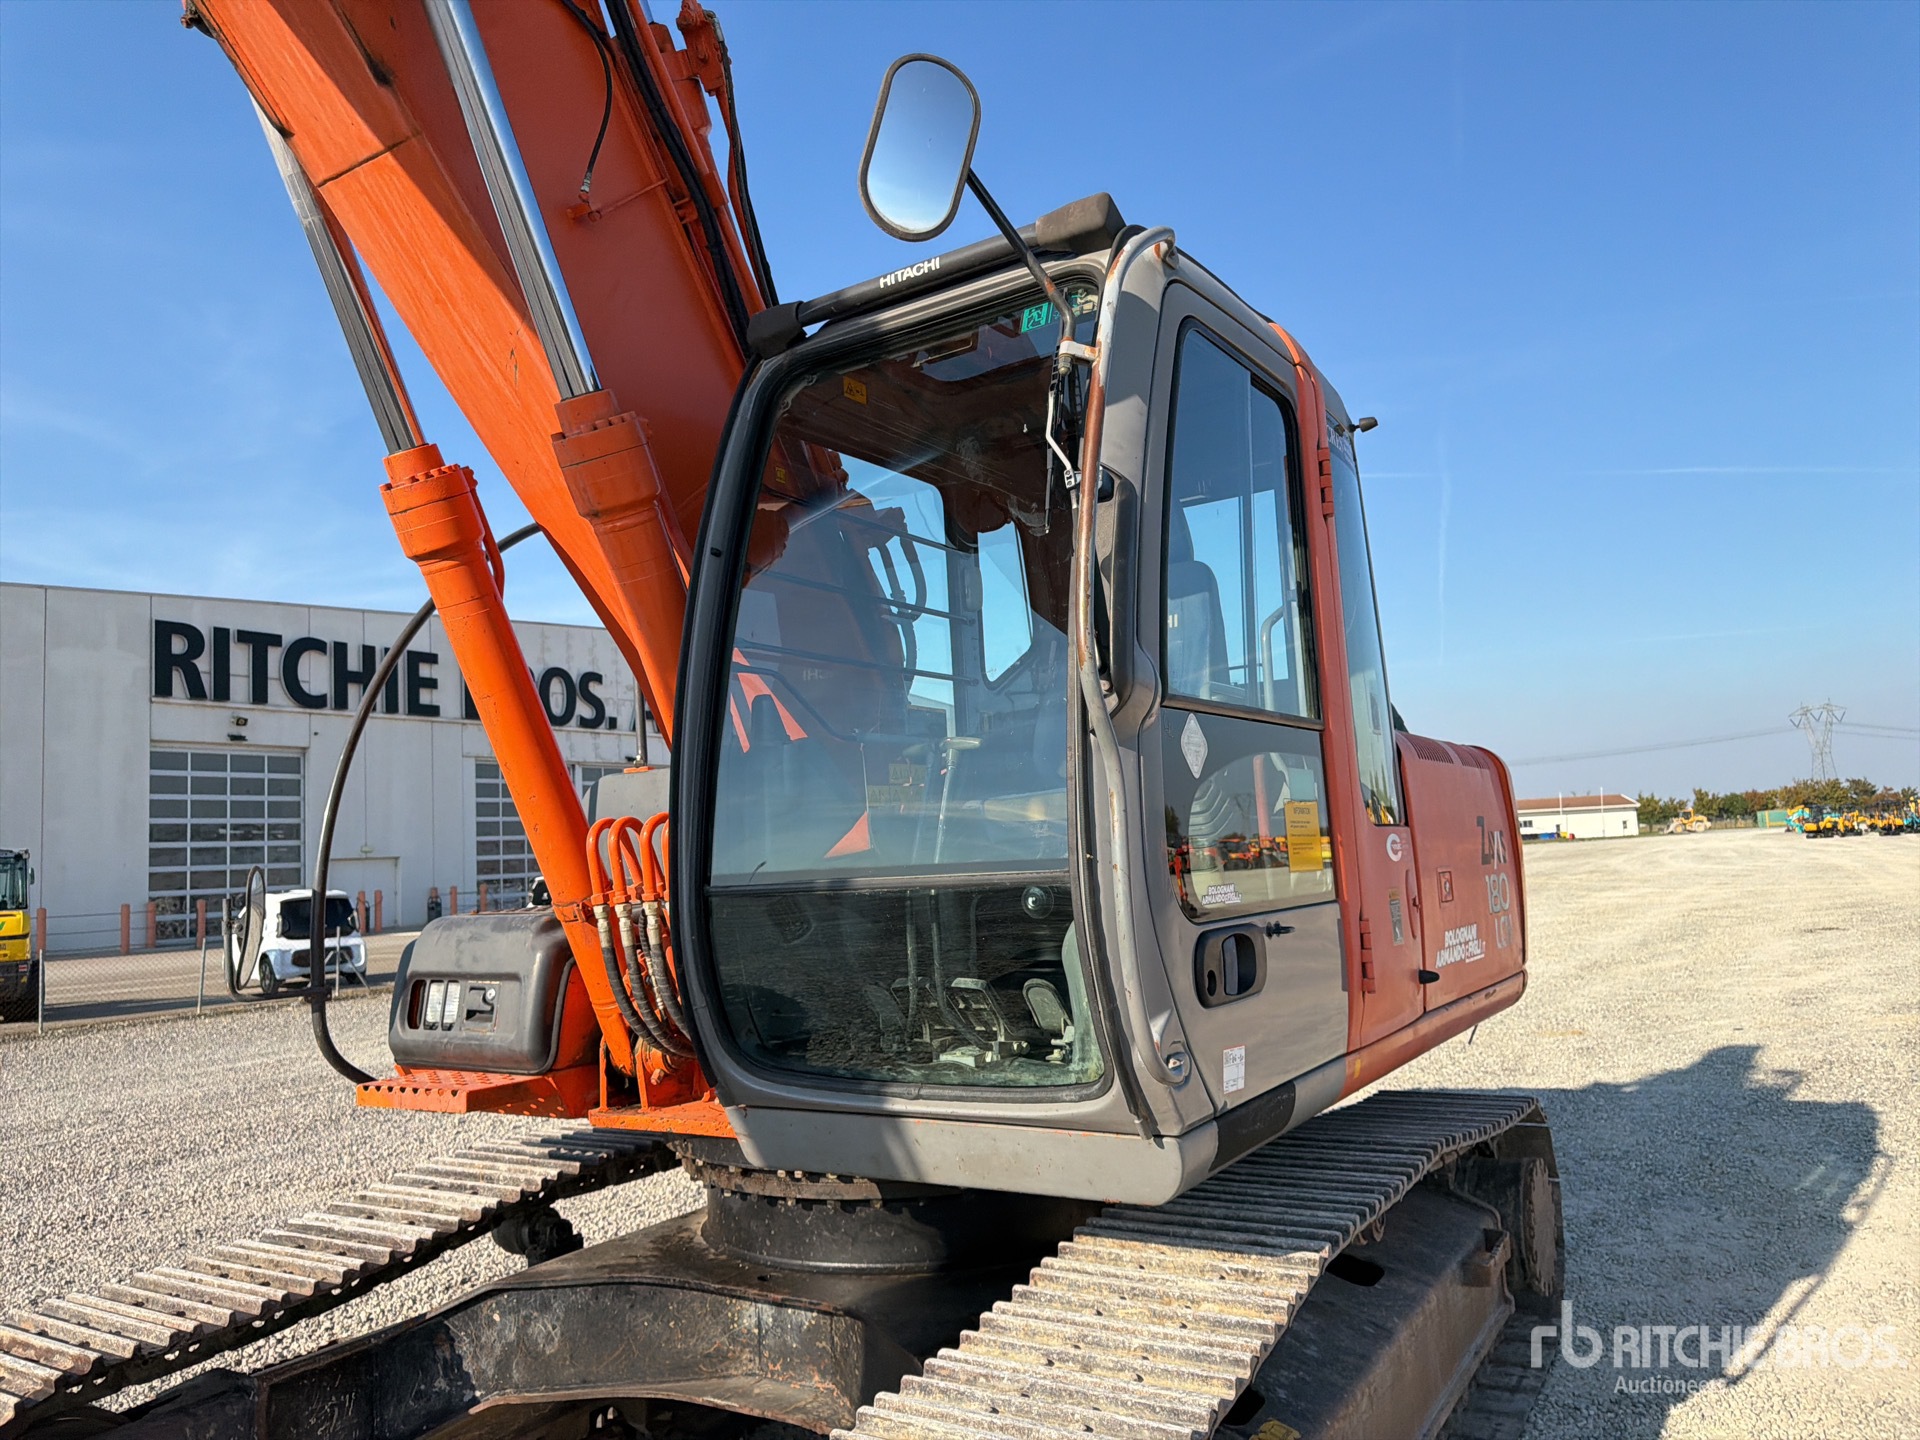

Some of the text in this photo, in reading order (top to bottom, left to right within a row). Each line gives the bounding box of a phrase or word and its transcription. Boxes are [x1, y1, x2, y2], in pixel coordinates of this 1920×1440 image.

[879, 257, 940, 289] HITACHI
[154, 619, 440, 718] RITCHIE
[464, 665, 618, 729] OS.
[1485, 872, 1510, 914] 180
